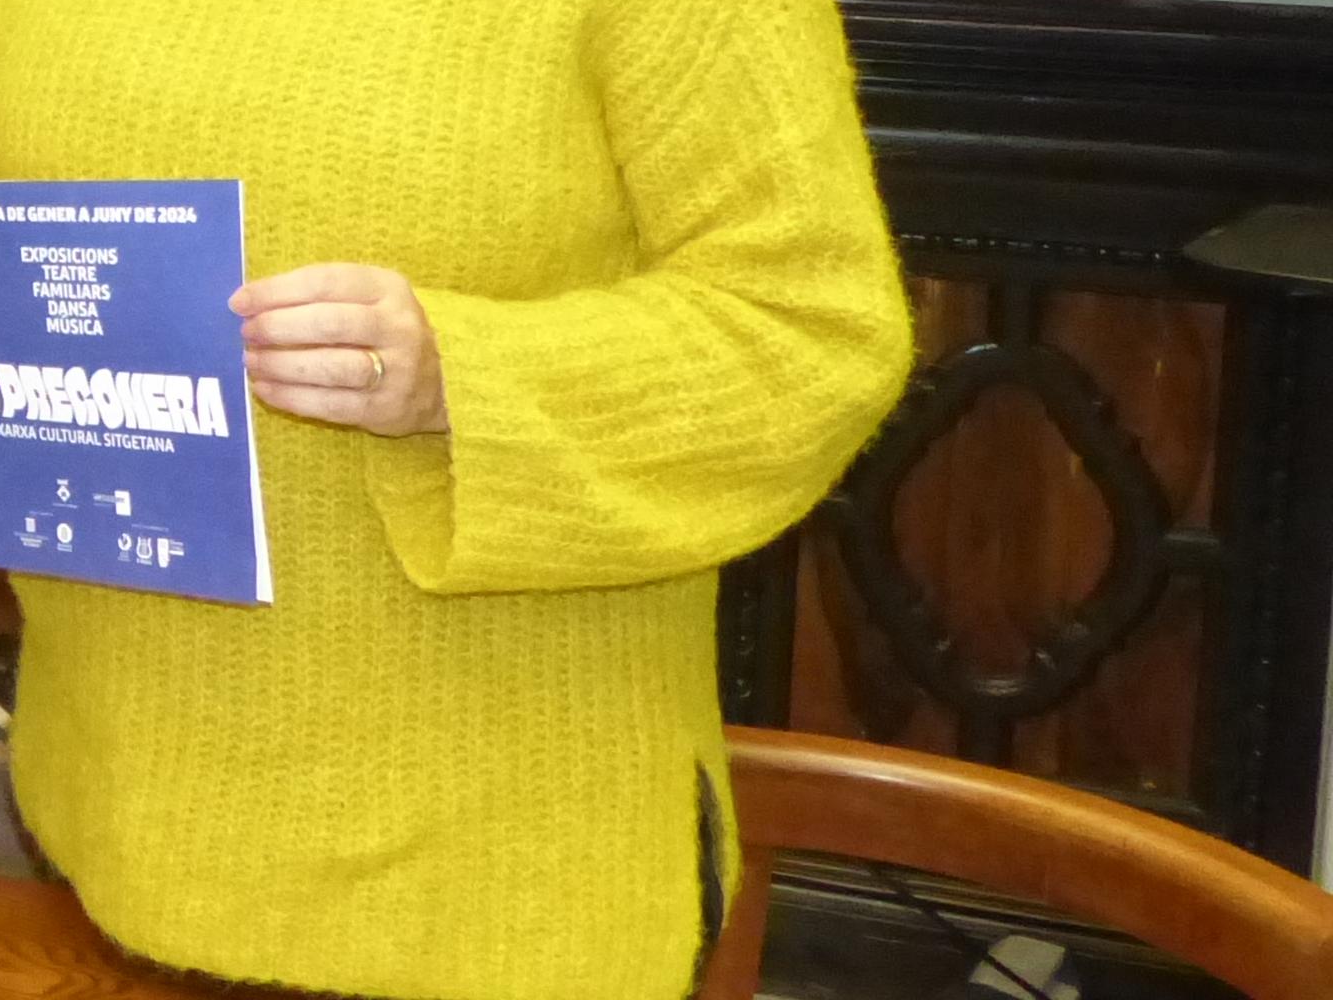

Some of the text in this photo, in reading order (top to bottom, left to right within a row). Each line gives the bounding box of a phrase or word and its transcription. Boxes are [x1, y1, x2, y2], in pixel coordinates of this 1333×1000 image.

[7, 206, 25, 222] DE
[27, 206, 77, 223] GENER
[77, 207, 90, 223] A
[91, 207, 132, 224] JUNY
[134, 207, 155, 224] DE
[157, 207, 197, 224] 2024
[20, 247, 118, 266] EXPOSICIONS
[42, 265, 97, 283] TEATRE
[32, 282, 111, 301] FAMILIARS
[48, 300, 98, 317] DANSA
[46, 312, 103, 336] MÚSICA
[39, 426, 102, 447] CULTURAL
[103, 433, 175, 454] SITGETANA
